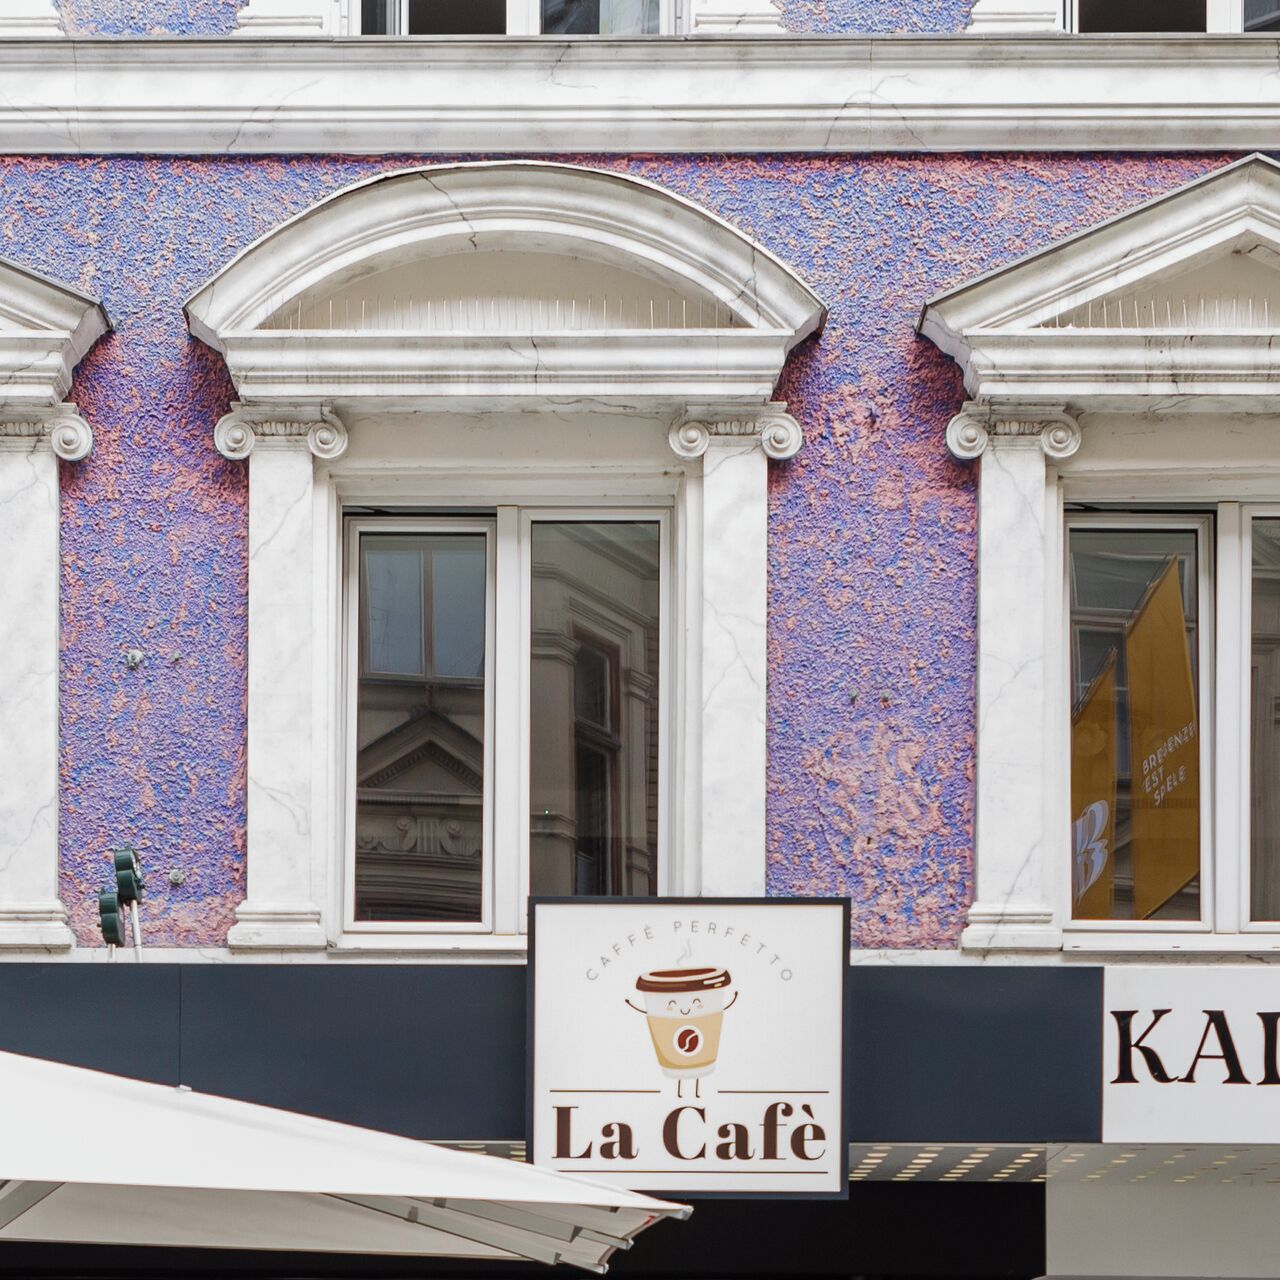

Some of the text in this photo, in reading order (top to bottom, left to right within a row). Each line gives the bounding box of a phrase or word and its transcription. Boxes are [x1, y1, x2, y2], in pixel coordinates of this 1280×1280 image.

[673, 919, 794, 982] PERFETTO
[552, 1101, 827, 1161] La Cafè
